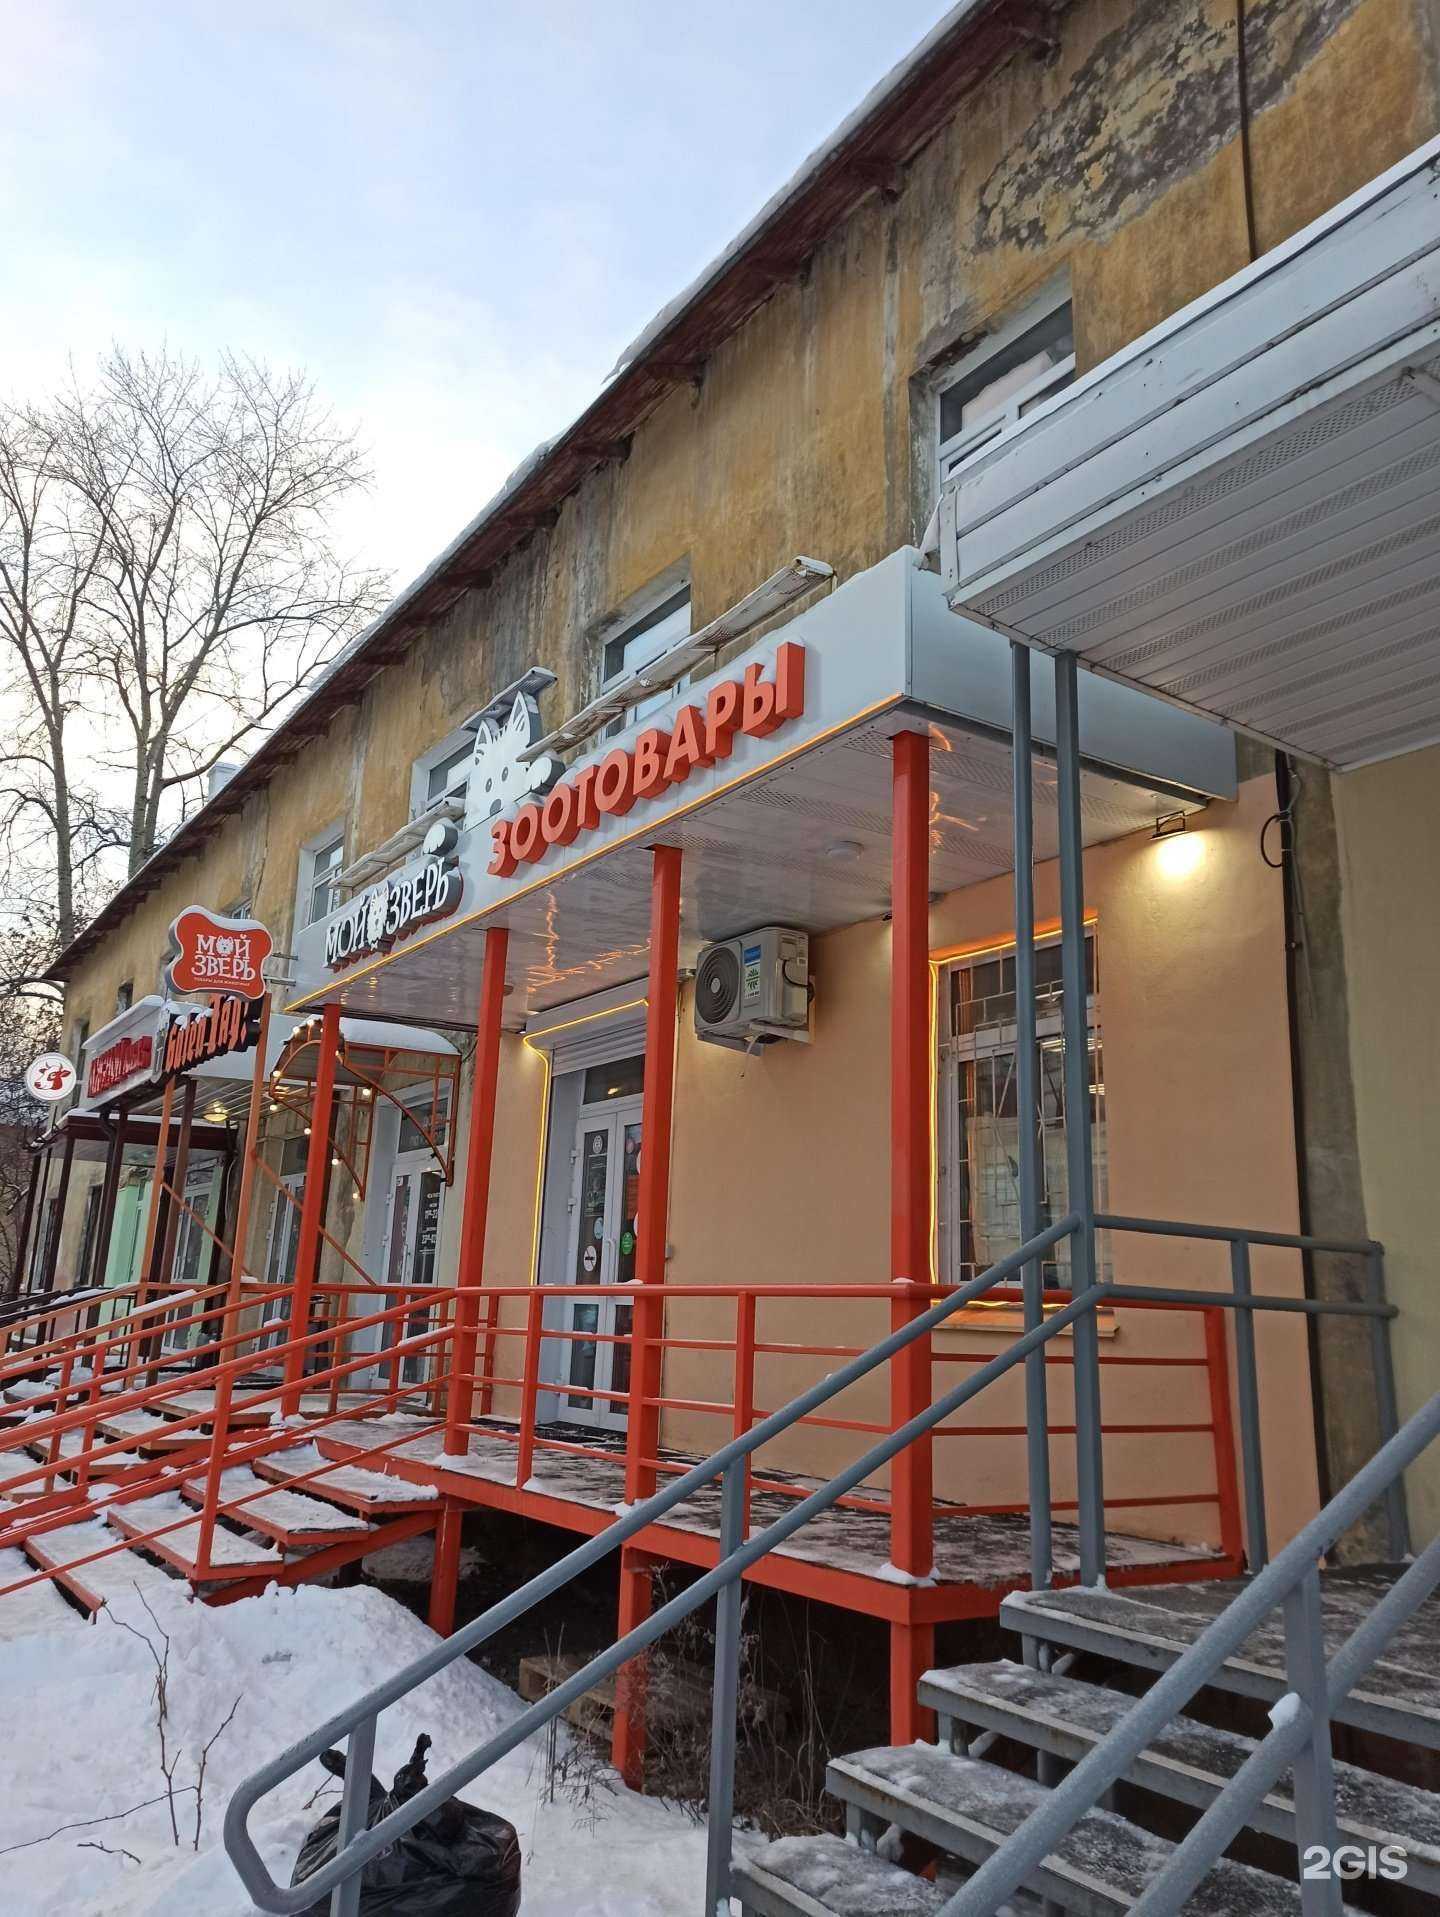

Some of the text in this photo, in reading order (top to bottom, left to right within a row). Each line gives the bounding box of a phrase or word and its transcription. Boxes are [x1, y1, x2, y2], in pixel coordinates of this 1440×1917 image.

[487, 641, 806, 878] ЗООТОВАРЫ
[195, 933, 252, 960] МОЙ
[323, 857, 451, 968] МОЙ ЗВЕРЬ
[191, 955, 256, 981] ЗВЕРЬ
